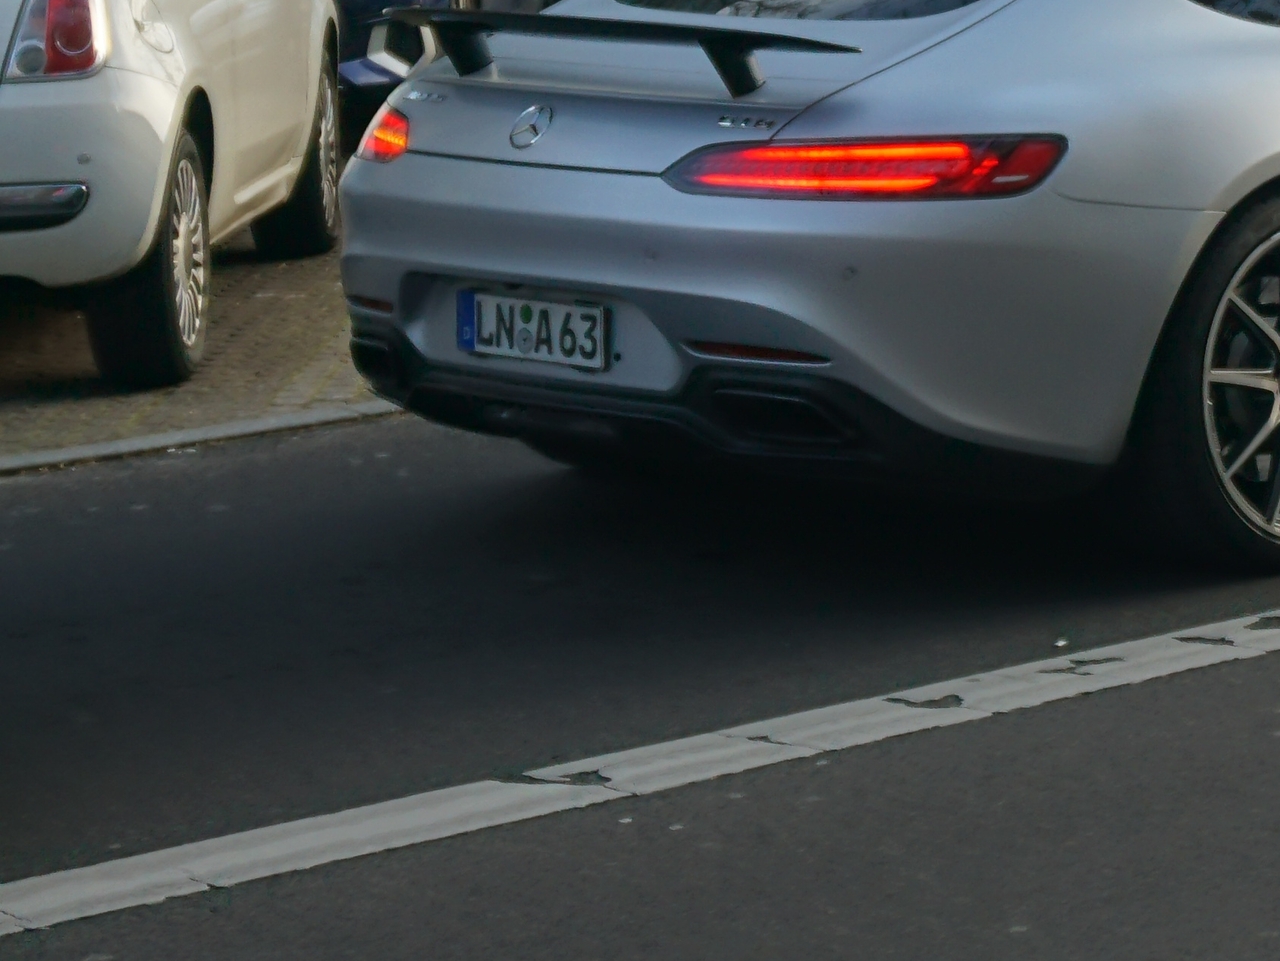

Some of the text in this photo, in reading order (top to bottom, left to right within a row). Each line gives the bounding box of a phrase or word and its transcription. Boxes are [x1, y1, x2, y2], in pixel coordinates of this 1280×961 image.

[476, 300, 515, 350] LN
[533, 308, 553, 356] A
[559, 311, 598, 360] 63
